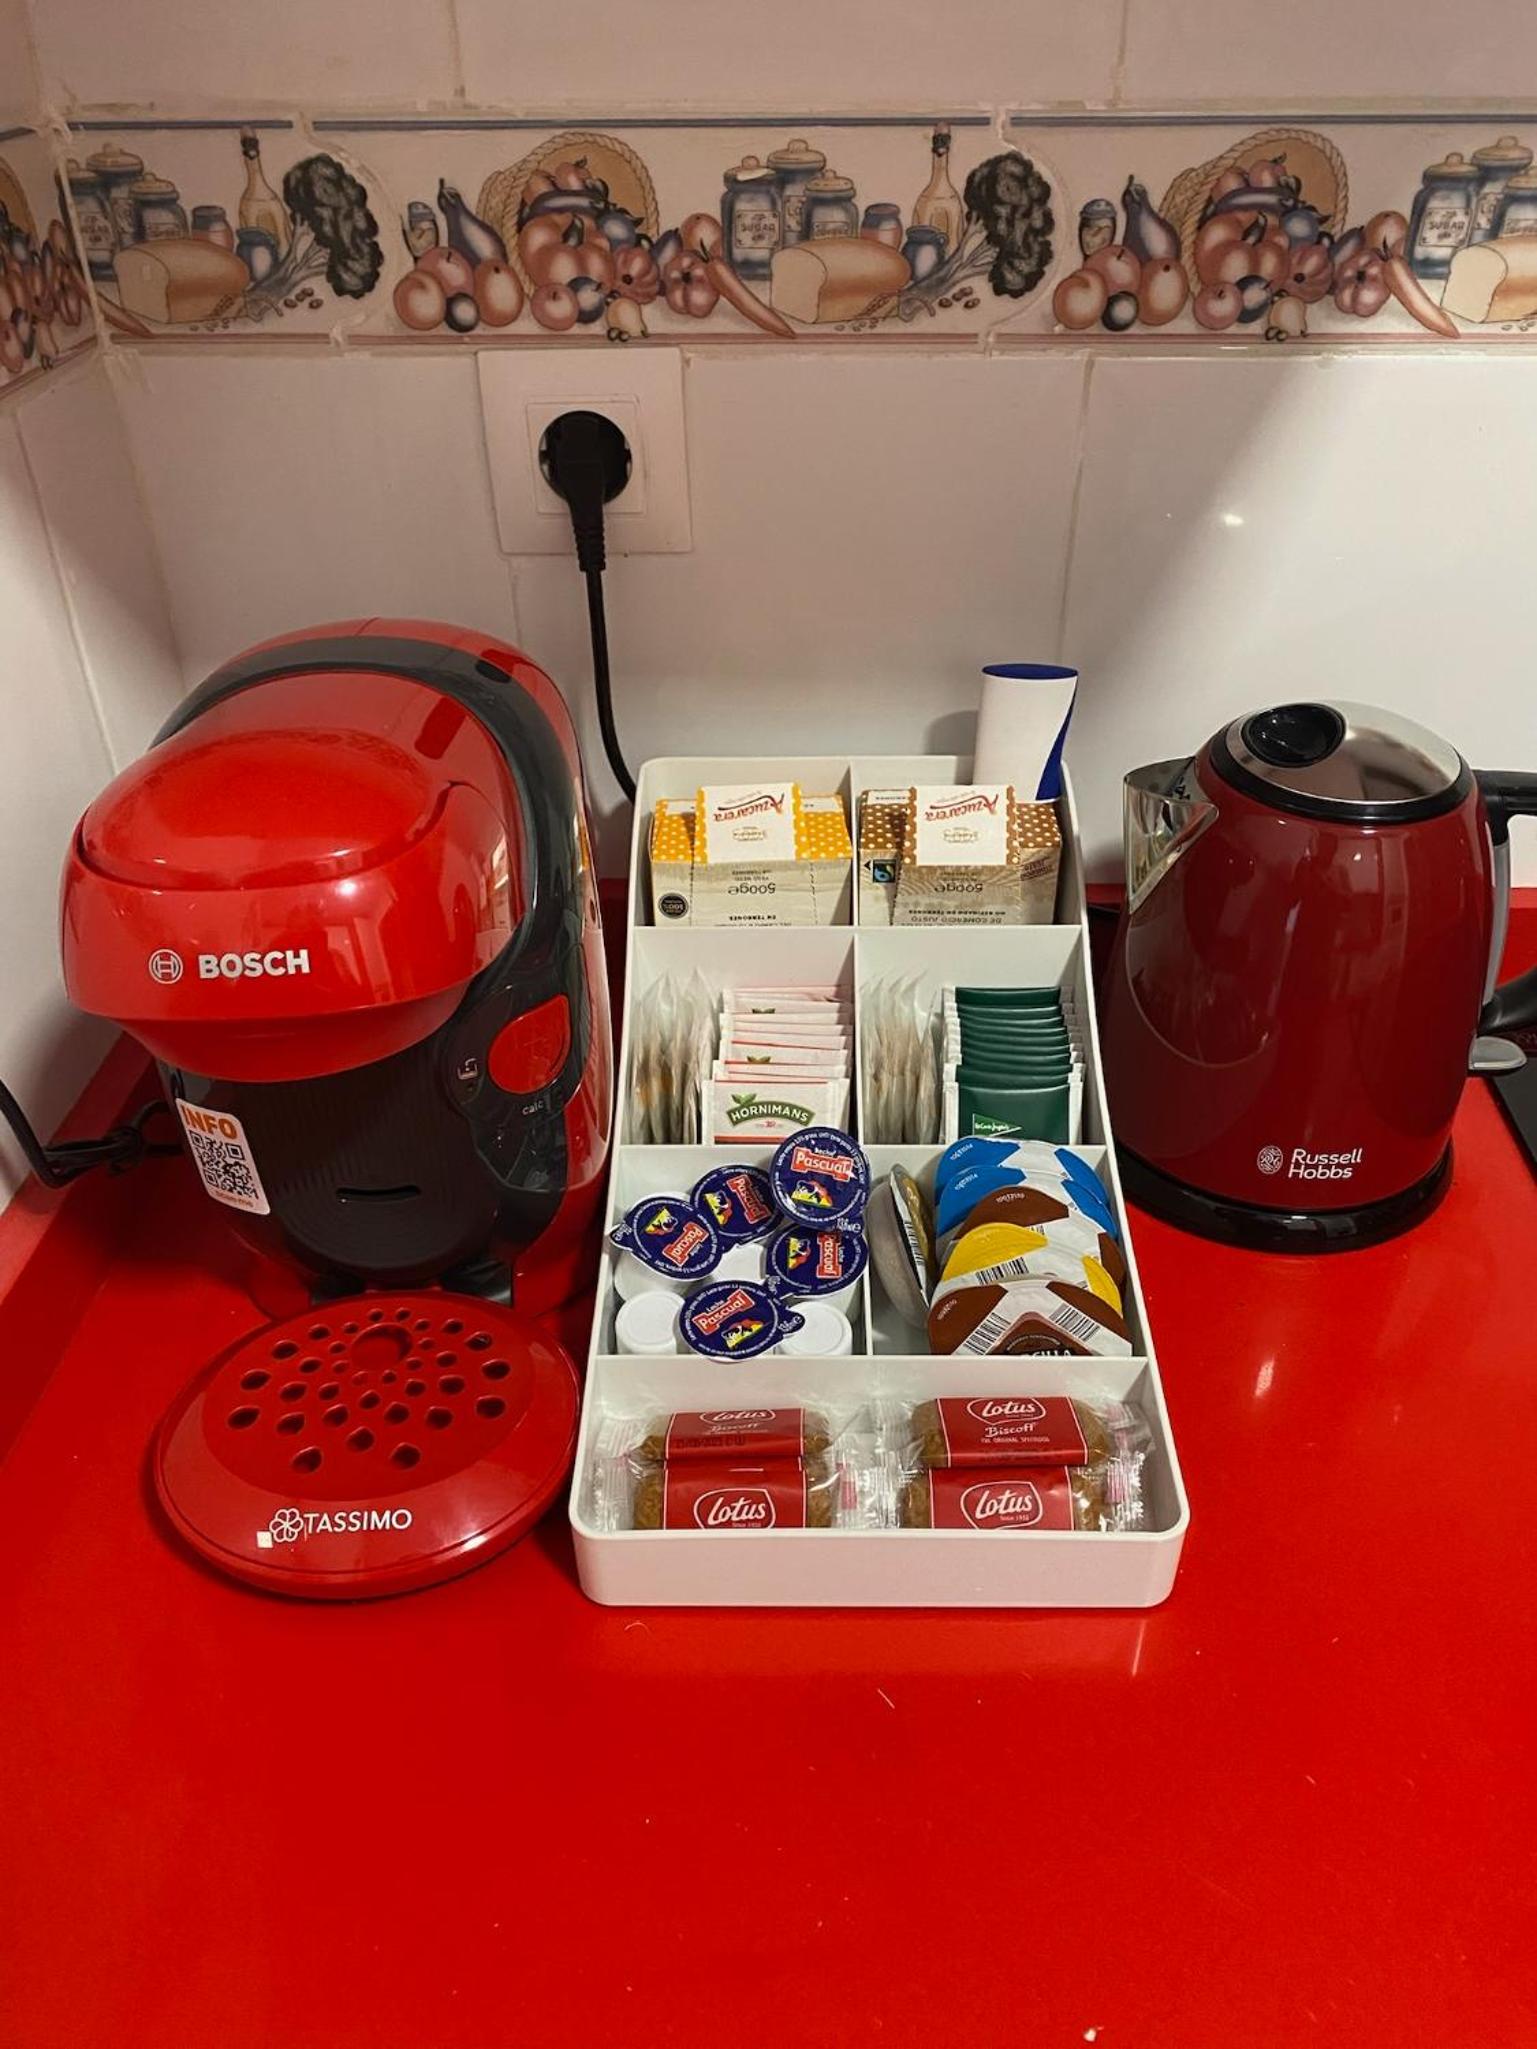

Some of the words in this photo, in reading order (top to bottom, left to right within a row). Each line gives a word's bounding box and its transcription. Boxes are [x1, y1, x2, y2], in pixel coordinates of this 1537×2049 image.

[198, 949, 310, 979] BOSCH
[181, 1105, 238, 1139] INFO
[731, 1104, 809, 1121] HORNIMANS
[796, 1150, 851, 1174] Pascual
[1291, 1148, 1363, 1165] Russell
[1288, 1164, 1353, 1179] Hobbs
[736, 1177, 767, 1217] Pascual
[671, 1226, 704, 1261] Pascual
[698, 1296, 747, 1329] Pascual
[712, 1411, 766, 1421] Lotus
[982, 1401, 1035, 1417] Lotus
[707, 1497, 766, 1525] Lotus
[975, 1489, 1032, 1519] Lotus
[303, 1508, 413, 1534] TASSIMO
